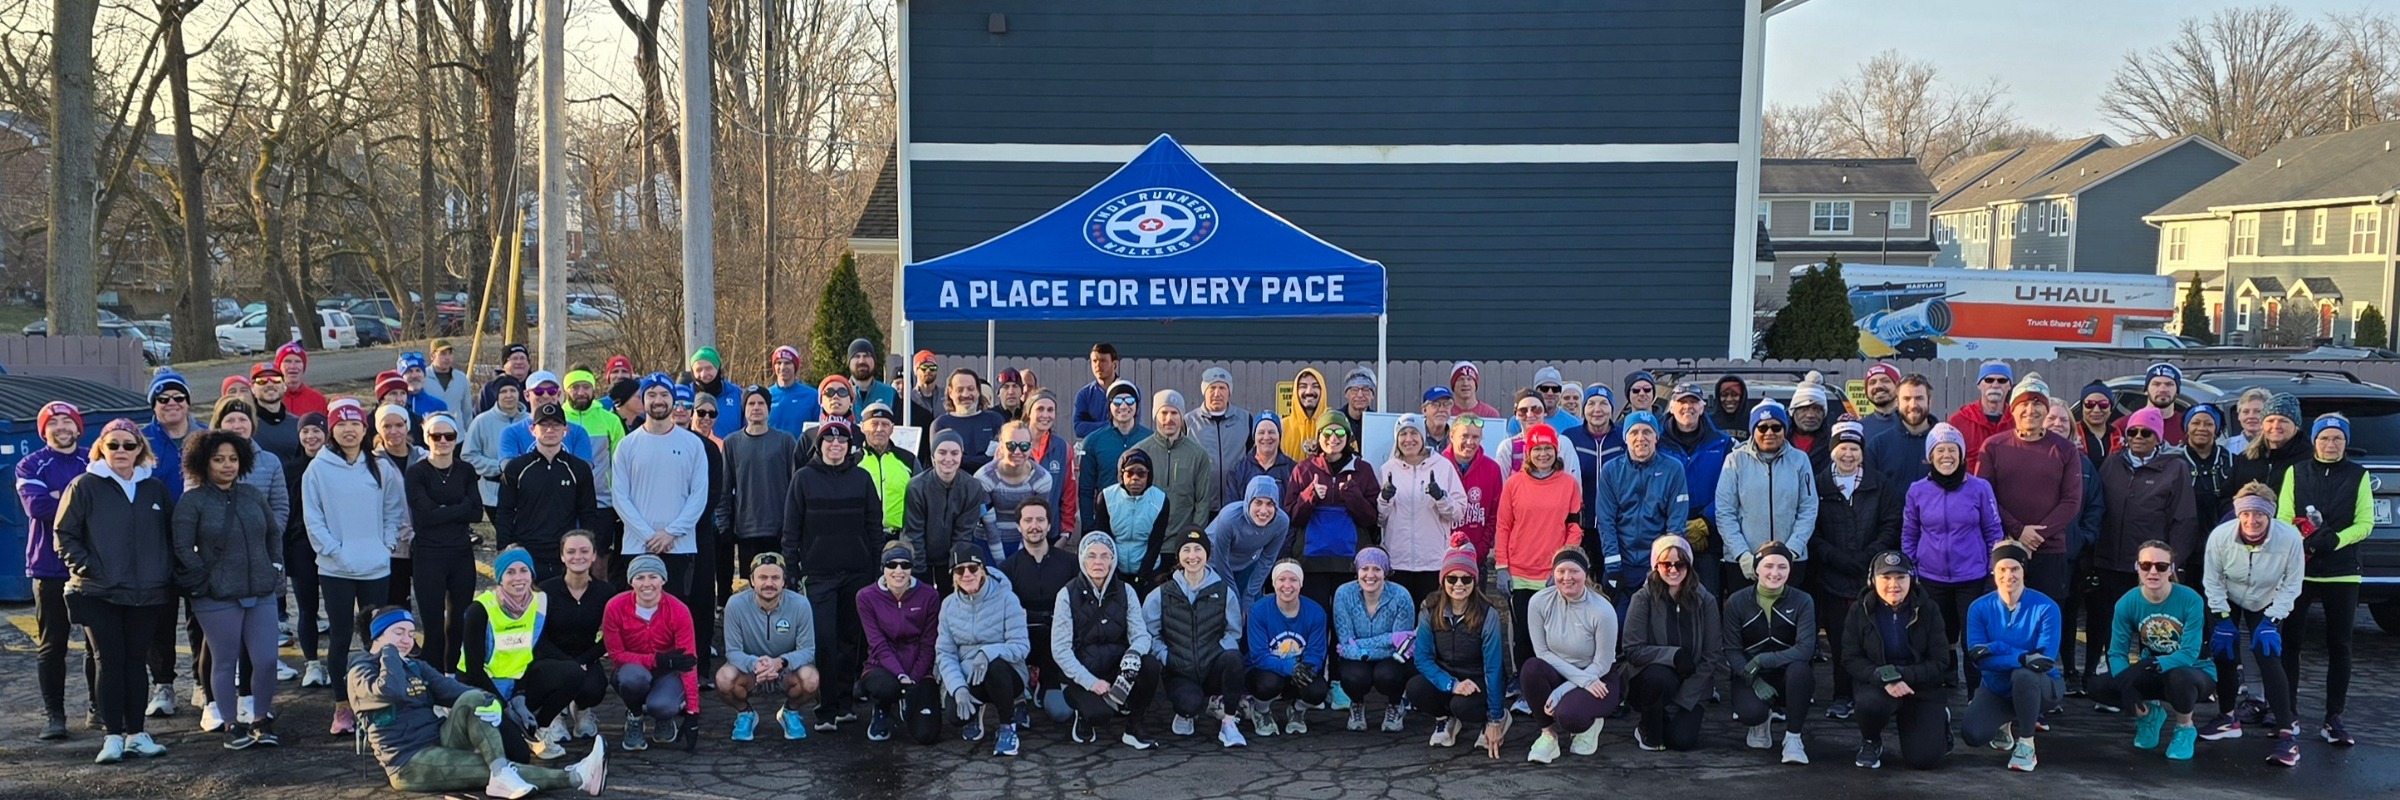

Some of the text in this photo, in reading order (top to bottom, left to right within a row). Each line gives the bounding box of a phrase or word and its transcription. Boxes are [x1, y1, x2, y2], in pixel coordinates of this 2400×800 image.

[1093, 191, 1211, 223] INDY RUNNERS
[1103, 241, 1191, 256] WALKERS
[939, 274, 1345, 308] A PLACE FOR EVERY PACE
[2015, 285, 2116, 304] U-HAUL
[2027, 318, 2092, 329] Truck Share 24/7
[20, 439, 29, 456] 6
